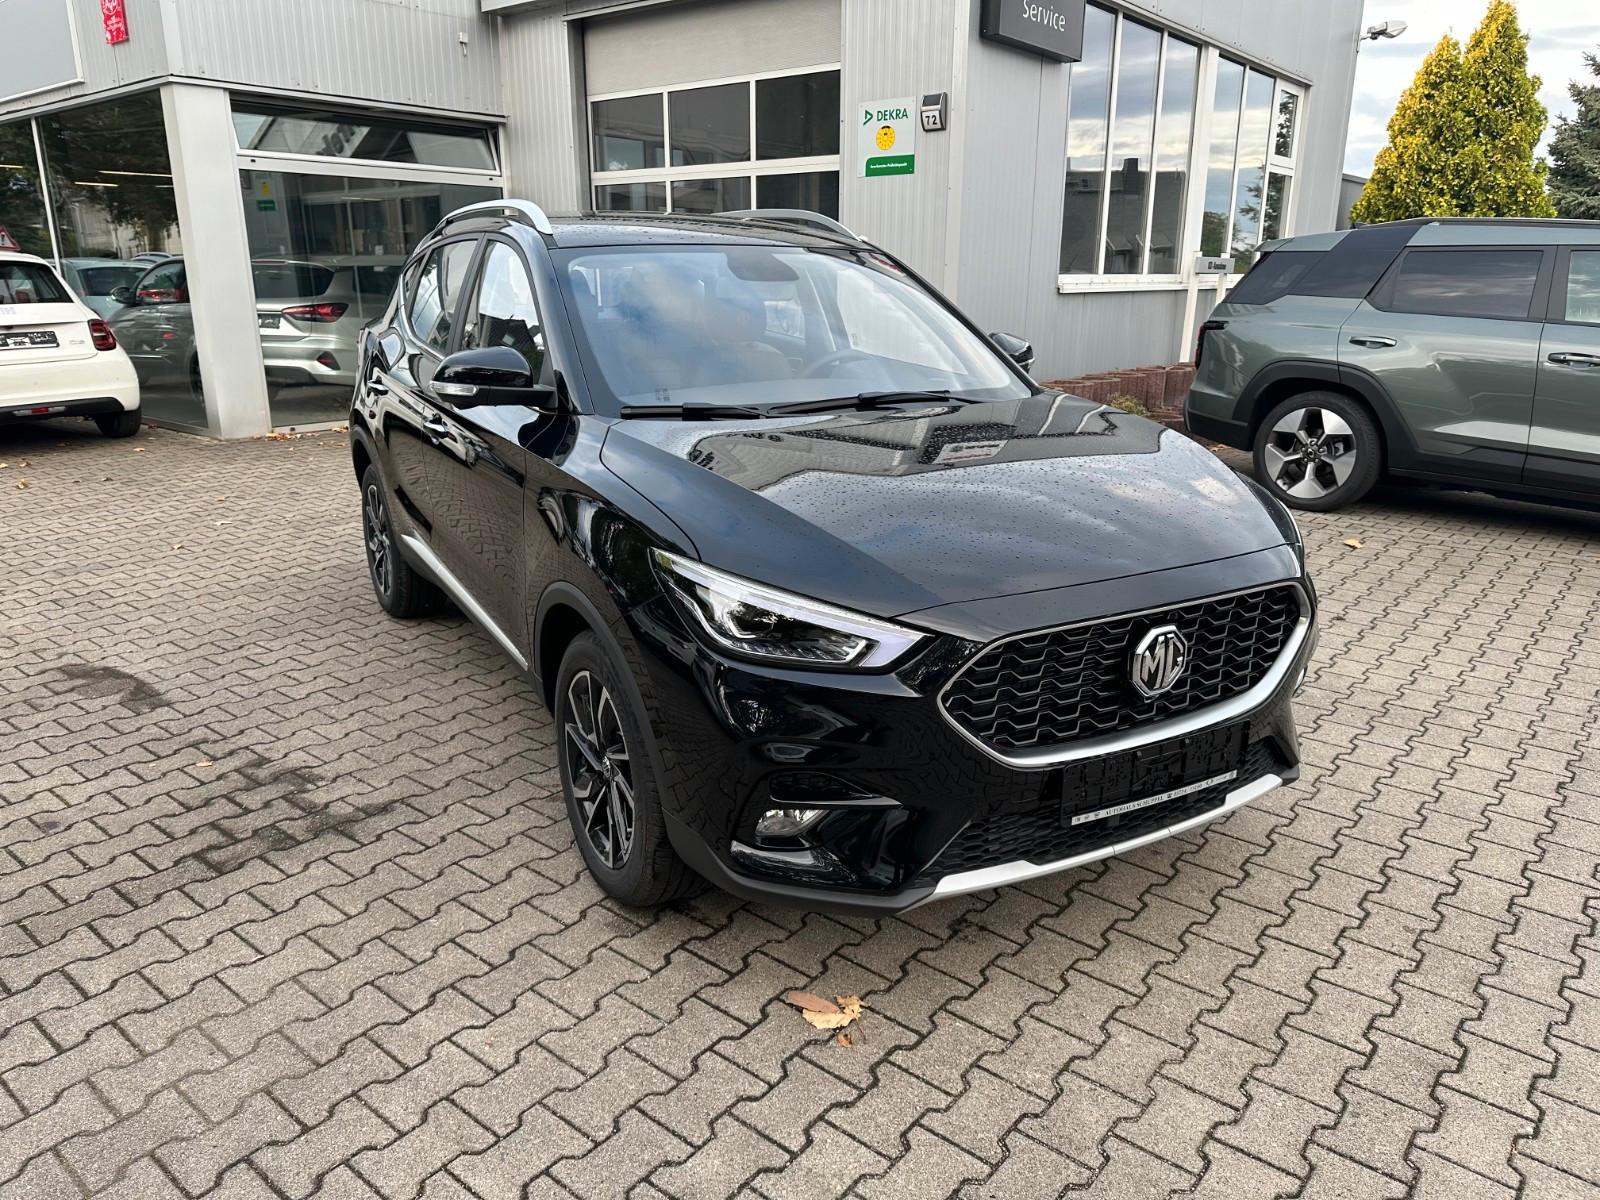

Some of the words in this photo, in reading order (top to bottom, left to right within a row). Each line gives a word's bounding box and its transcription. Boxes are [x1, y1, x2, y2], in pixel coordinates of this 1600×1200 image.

[1022, 0, 1066, 32] Service
[876, 108, 909, 122] DEKRA
[925, 114, 938, 126] 72
[1140, 633, 1184, 690] MG
